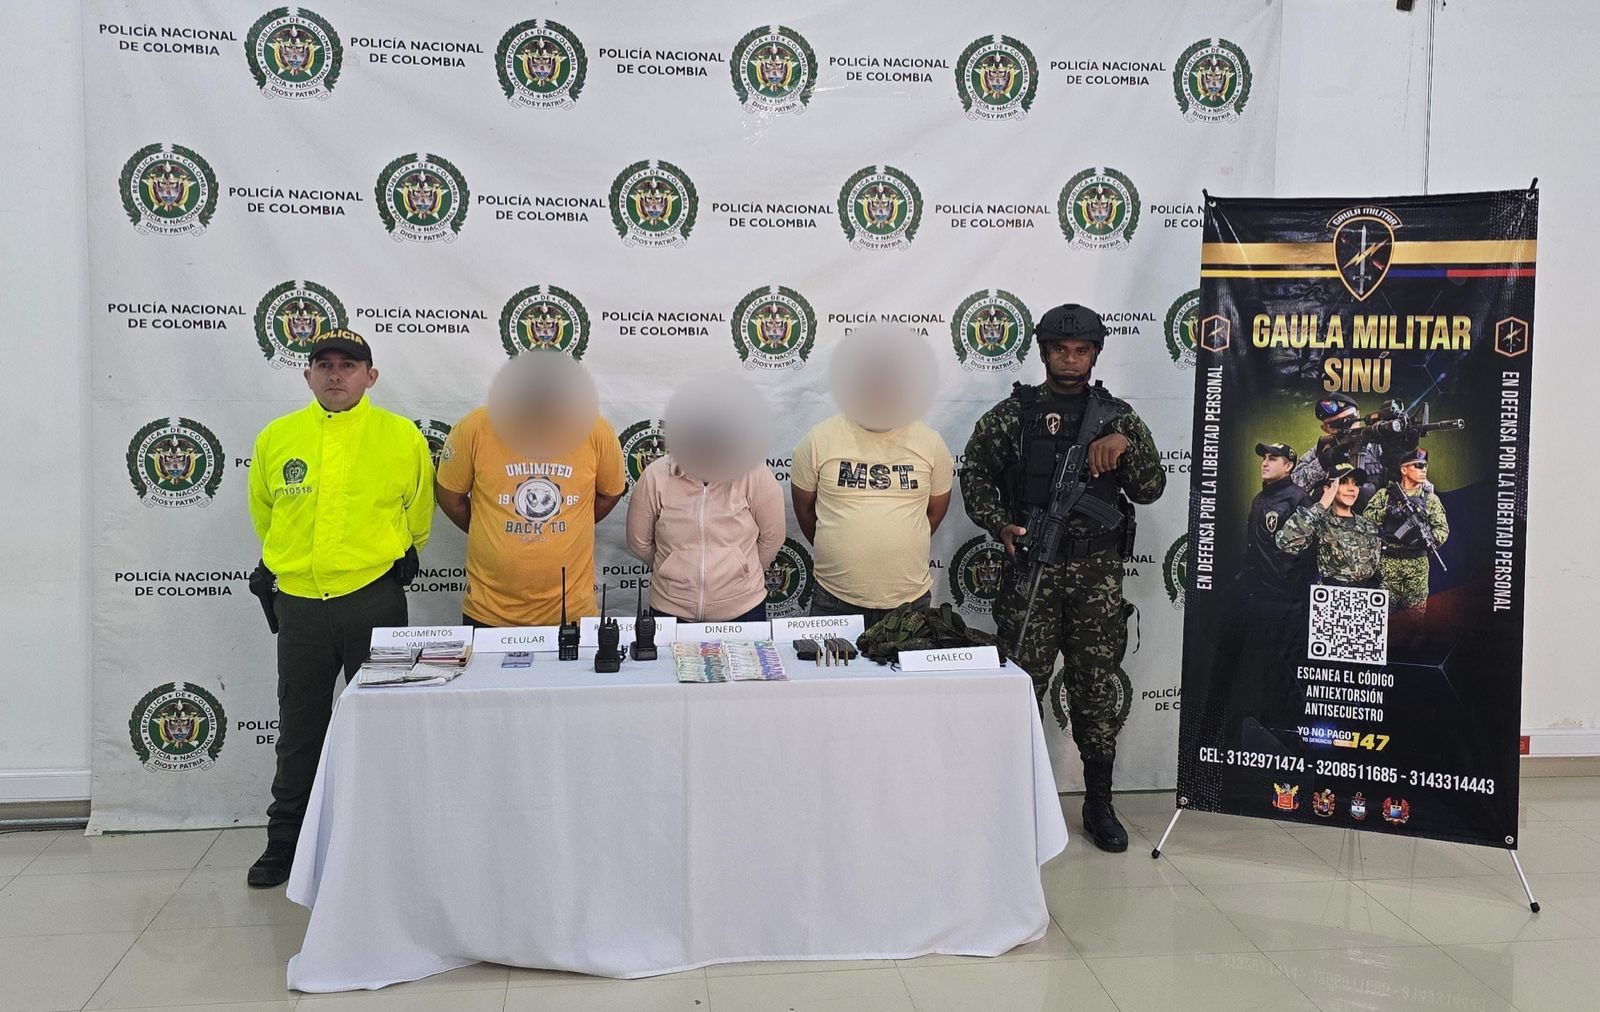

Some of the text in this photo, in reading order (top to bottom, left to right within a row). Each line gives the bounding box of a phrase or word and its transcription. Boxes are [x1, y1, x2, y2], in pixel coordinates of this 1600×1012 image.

[99, 22, 238, 42] POLICÍA NACIONAL
[119, 40, 220, 56] DE COLOMBIA
[308, 22, 331, 61] COLOMBIA
[350, 36, 484, 54] POLICÍA NACIONAL
[369, 52, 466, 68] DE COLOMBIA
[599, 46, 725, 63] POLICÍA NACIONAL
[830, 55, 950, 69] POLICÍA NACIONAL
[1050, 58, 1167, 72] POLICÍA NACIONAL
[616, 63, 708, 77] DE COLOMBIA
[846, 71, 933, 83] DE COLOMBIA
[295, 69, 328, 88] NACIONAL
[1066, 75, 1150, 86] DE COLOMBIA
[296, 88, 320, 98] PATRIA
[182, 159, 206, 197] COLOMBIA
[228, 184, 364, 202] POLICÍA NACIONAL
[477, 194, 607, 209] POLICÍA NACIONAL
[712, 200, 834, 215] POLICÍA NACIONAL
[935, 201, 1051, 215] POLICÍA NACIONAL
[1150, 201, 1195, 215] POLICÍA
[170, 204, 203, 223] NACIONAL
[247, 202, 346, 216] DE COLOMBIA
[495, 210, 589, 223] DE COLOMBIA
[729, 217, 817, 228] DE COLOMBIA
[951, 218, 1035, 228] DE COLOMBIA
[1164, 218, 1178, 229] DE
[1332, 207, 1398, 226] GAULA MILITAR
[170, 223, 195, 233] PATRIA
[107, 300, 247, 316] POLICÍA NACIONAL
[356, 305, 488, 320] POLICÍA NACIONAL
[602, 310, 726, 322] POLICÍA NACIONAL
[828, 312, 946, 324] POLICÍA NACIONAL
[1100, 313, 1157, 322] NACIONAL
[127, 318, 227, 330] DE COLOMBIA
[375, 322, 470, 334] DE COLOMBIA
[619, 325, 709, 336] DE COLOMBIA
[1103, 326, 1140, 336] OMBIA
[1252, 314, 1472, 350] GAULA MILITAR
[1323, 351, 1392, 393] SINÚ
[190, 433, 213, 469] COLOMBIA
[1160, 449, 1192, 460] LICÍA
[505, 462, 573, 478] UNLIMITED
[837, 460, 919, 491] MST.
[1196, 365, 1223, 590] EN DEFENSA POR LA LIBERTAD PERSONAL
[176, 477, 211, 497] NACIONAL
[284, 486, 313, 496] 10518
[1493, 371, 1520, 612] EN DEFENSA POR LA LIBERTAD PERSONAL
[176, 496, 201, 506] PATRIA
[498, 494, 510, 505] 19
[505, 521, 567, 534] BACK TO
[115, 570, 249, 582] POLICÍA NACIONAL
[419, 568, 467, 578] NACIO
[134, 585, 233, 597] DE COLOMBIA
[620, 580, 637, 589] DE
[705, 625, 743, 634] DINERO
[787, 618, 849, 629] PROVEEDORES
[392, 629, 453, 638] DOCUMENTOS
[500, 635, 545, 645] CELULAR
[926, 652, 973, 662] CHALECO
[1297, 666, 1394, 687] ESCANEA EL CÓDIGO
[1306, 685, 1384, 704] ANTIEXTORSIÓN
[1154, 701, 1170, 712] DE
[1304, 702, 1384, 722] ANTISECUESTRO
[193, 697, 216, 732] COLOMBIA
[238, 719, 280, 730] POLIC
[256, 734, 275, 745] DE
[1297, 726, 1309, 736] YO
[1311, 728, 1325, 737] NO
[1327, 729, 1352, 740] PAGO
[1351, 732, 1390, 751] 147
[180, 742, 213, 761] NACIONAL
[179, 758, 204, 770] PATRIA
[1199, 747, 1224, 765] CEL:
[1226, 750, 1305, 773] 3132971474
[1316, 760, 1398, 784] 3208511685
[1409, 770, 1495, 795] 3143314443
